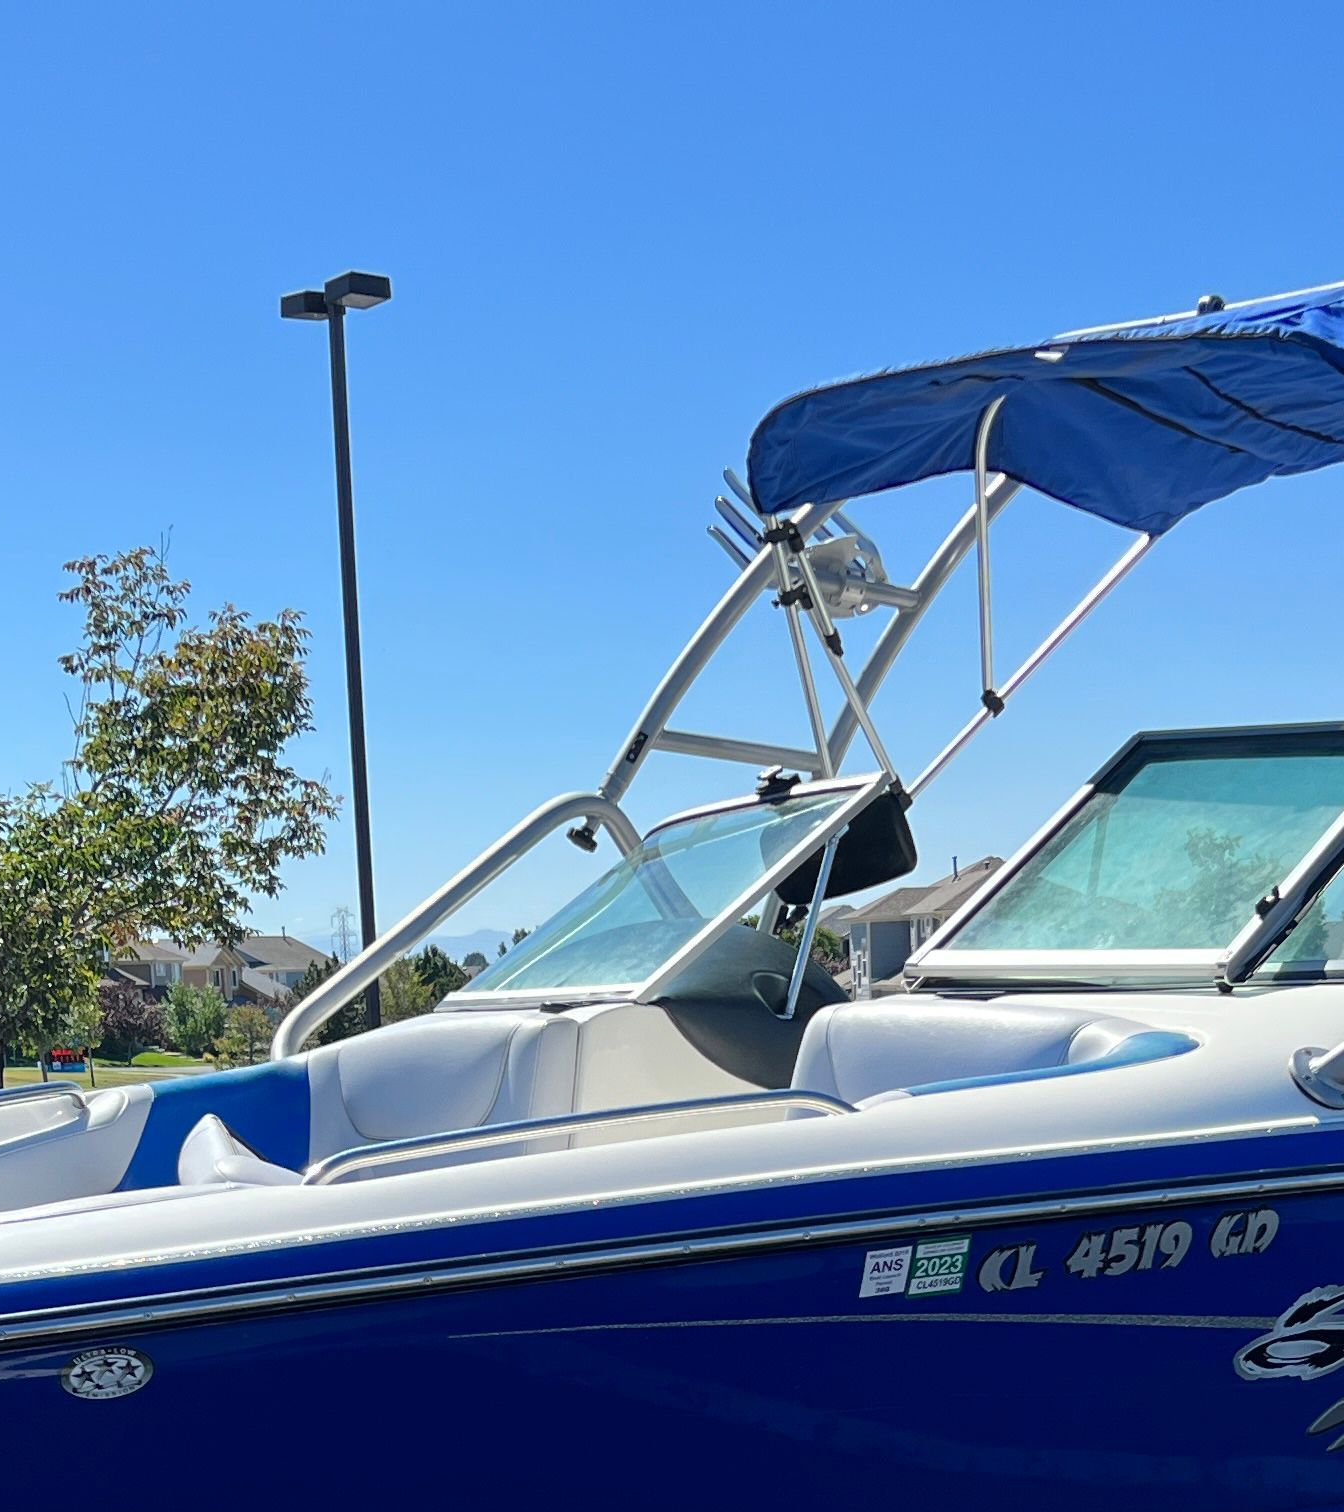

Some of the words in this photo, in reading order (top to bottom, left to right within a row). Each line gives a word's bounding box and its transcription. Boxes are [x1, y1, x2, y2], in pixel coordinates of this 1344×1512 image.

[978, 1243, 1045, 1293] CL
[1065, 1220, 1194, 1279] 4519
[1209, 1208, 1281, 1259] GD
[869, 1258, 904, 1275] ANS
[914, 1254, 963, 1278] 2023
[916, 1276, 960, 1291] CL4519GD
